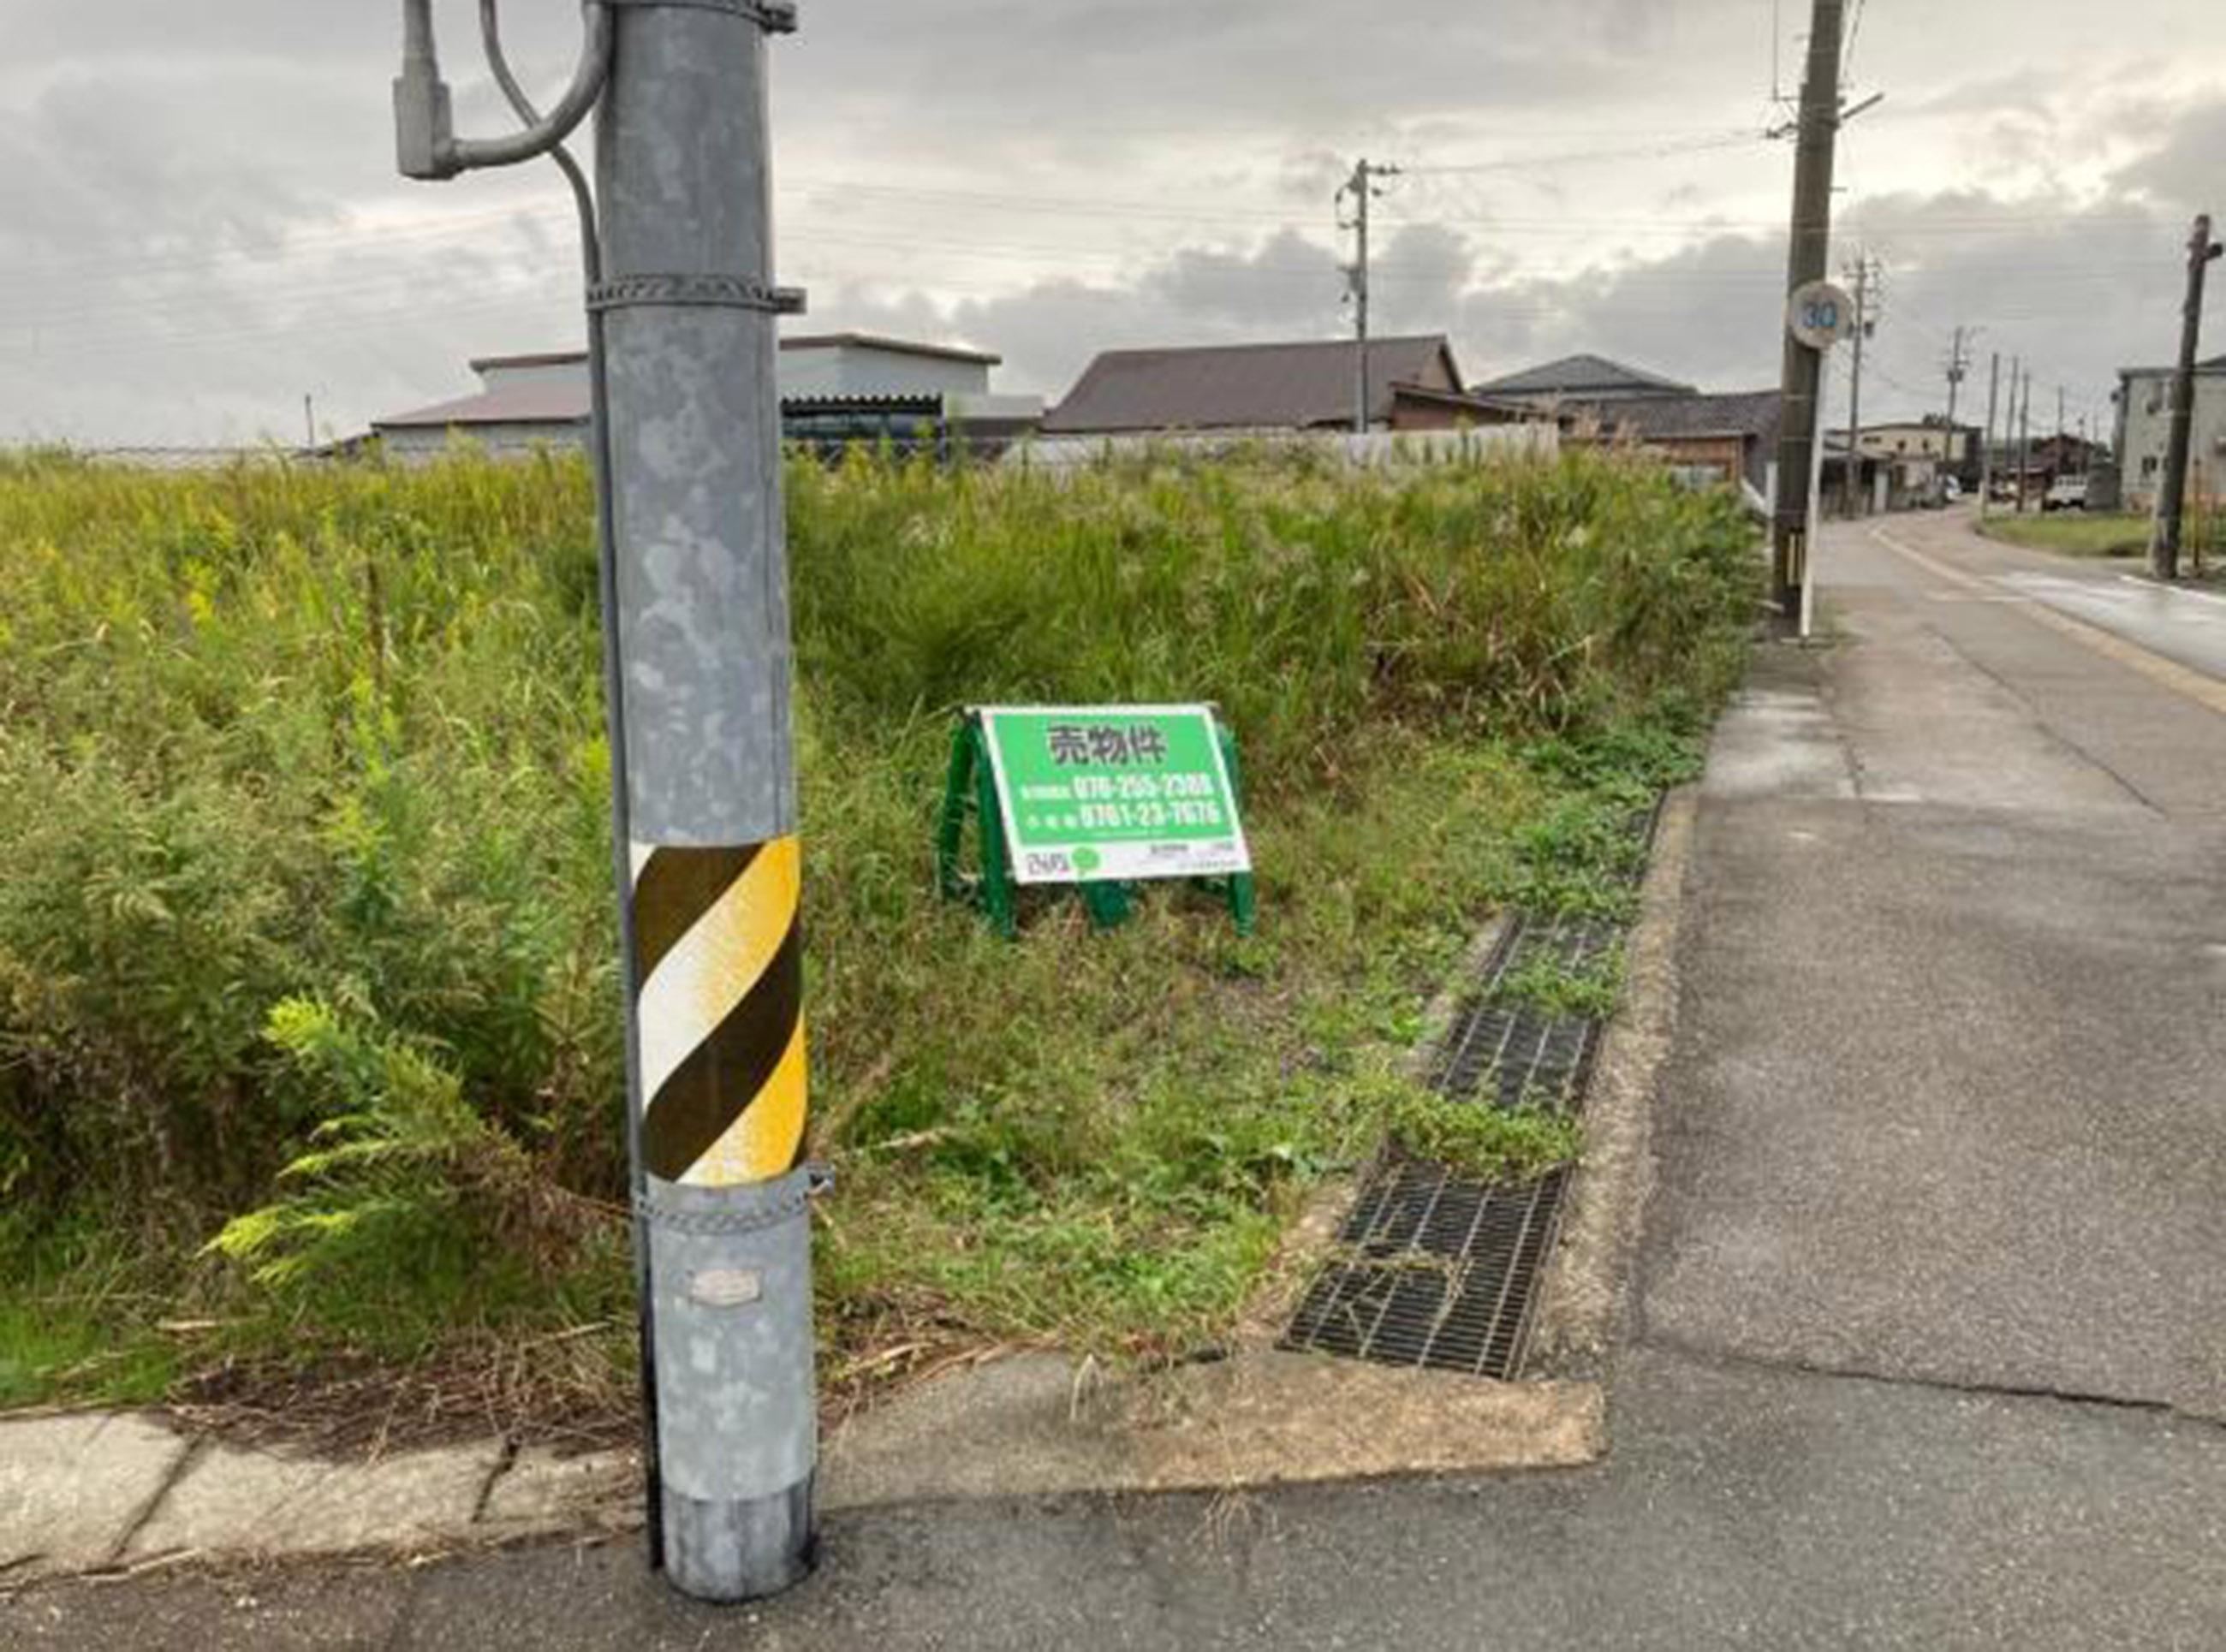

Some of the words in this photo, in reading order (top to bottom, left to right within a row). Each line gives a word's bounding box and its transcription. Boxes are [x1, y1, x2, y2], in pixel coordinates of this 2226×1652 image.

[1802, 300, 1836, 328] 30
[1047, 724, 1165, 764] 売物件
